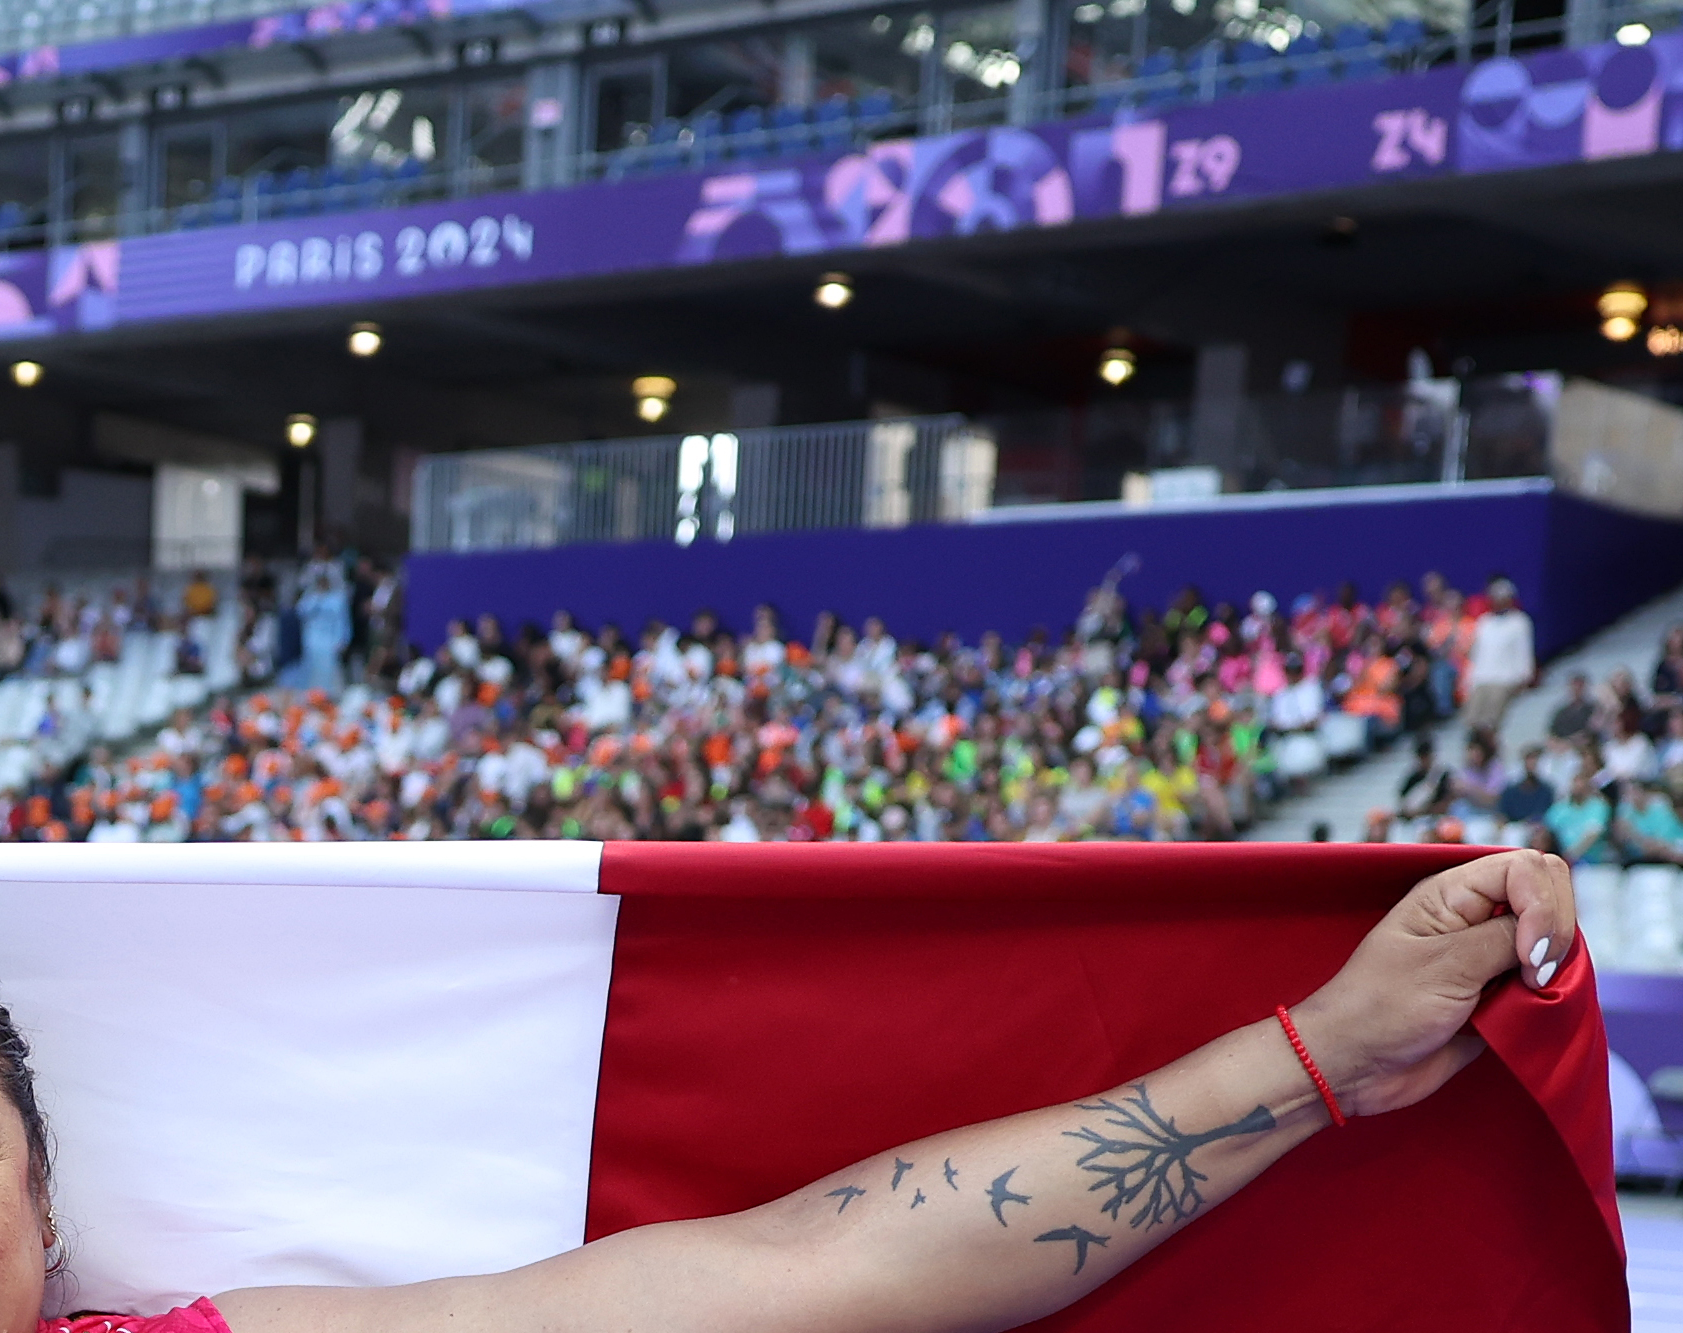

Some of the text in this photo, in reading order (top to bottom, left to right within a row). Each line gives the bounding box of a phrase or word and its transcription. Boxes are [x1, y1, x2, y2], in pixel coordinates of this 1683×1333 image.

[1169, 134, 1241, 196] Z9
[1371, 107, 1449, 173] Z4
[234, 213, 535, 289] PARIS 2024
